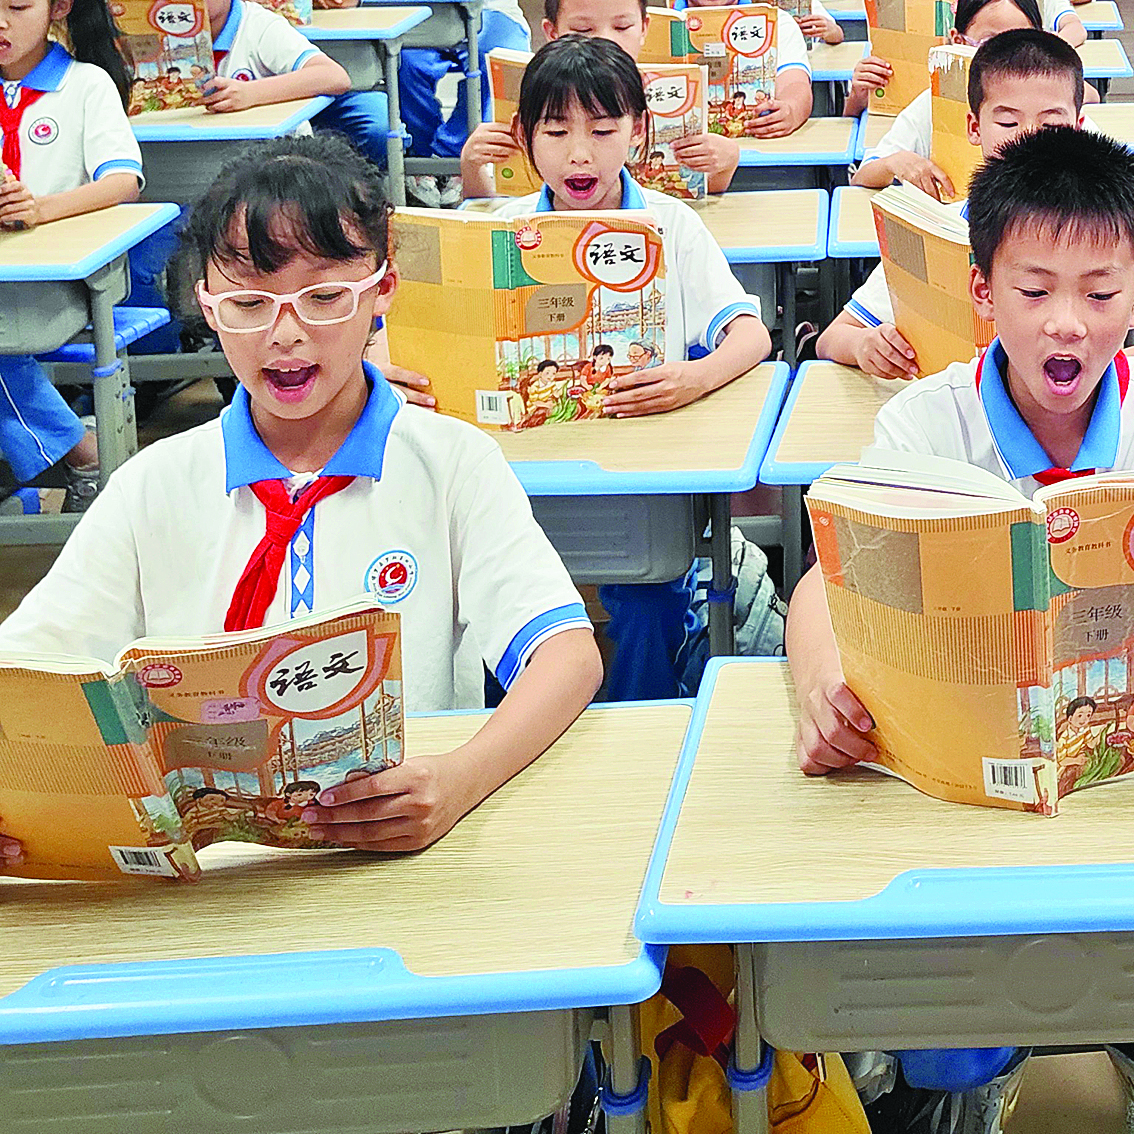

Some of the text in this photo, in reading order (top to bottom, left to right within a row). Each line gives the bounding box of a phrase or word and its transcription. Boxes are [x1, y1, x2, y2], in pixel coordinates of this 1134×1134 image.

[157, 11, 195, 24] 语文
[731, 25, 765, 41] 语文
[589, 242, 645, 266] 语文
[537, 296, 575, 310] 三年级
[548, 313, 566, 322] 下册
[1072, 603, 1123, 624] 三年级
[1085, 628, 1110, 643] 下册
[269, 650, 365, 697] 语文
